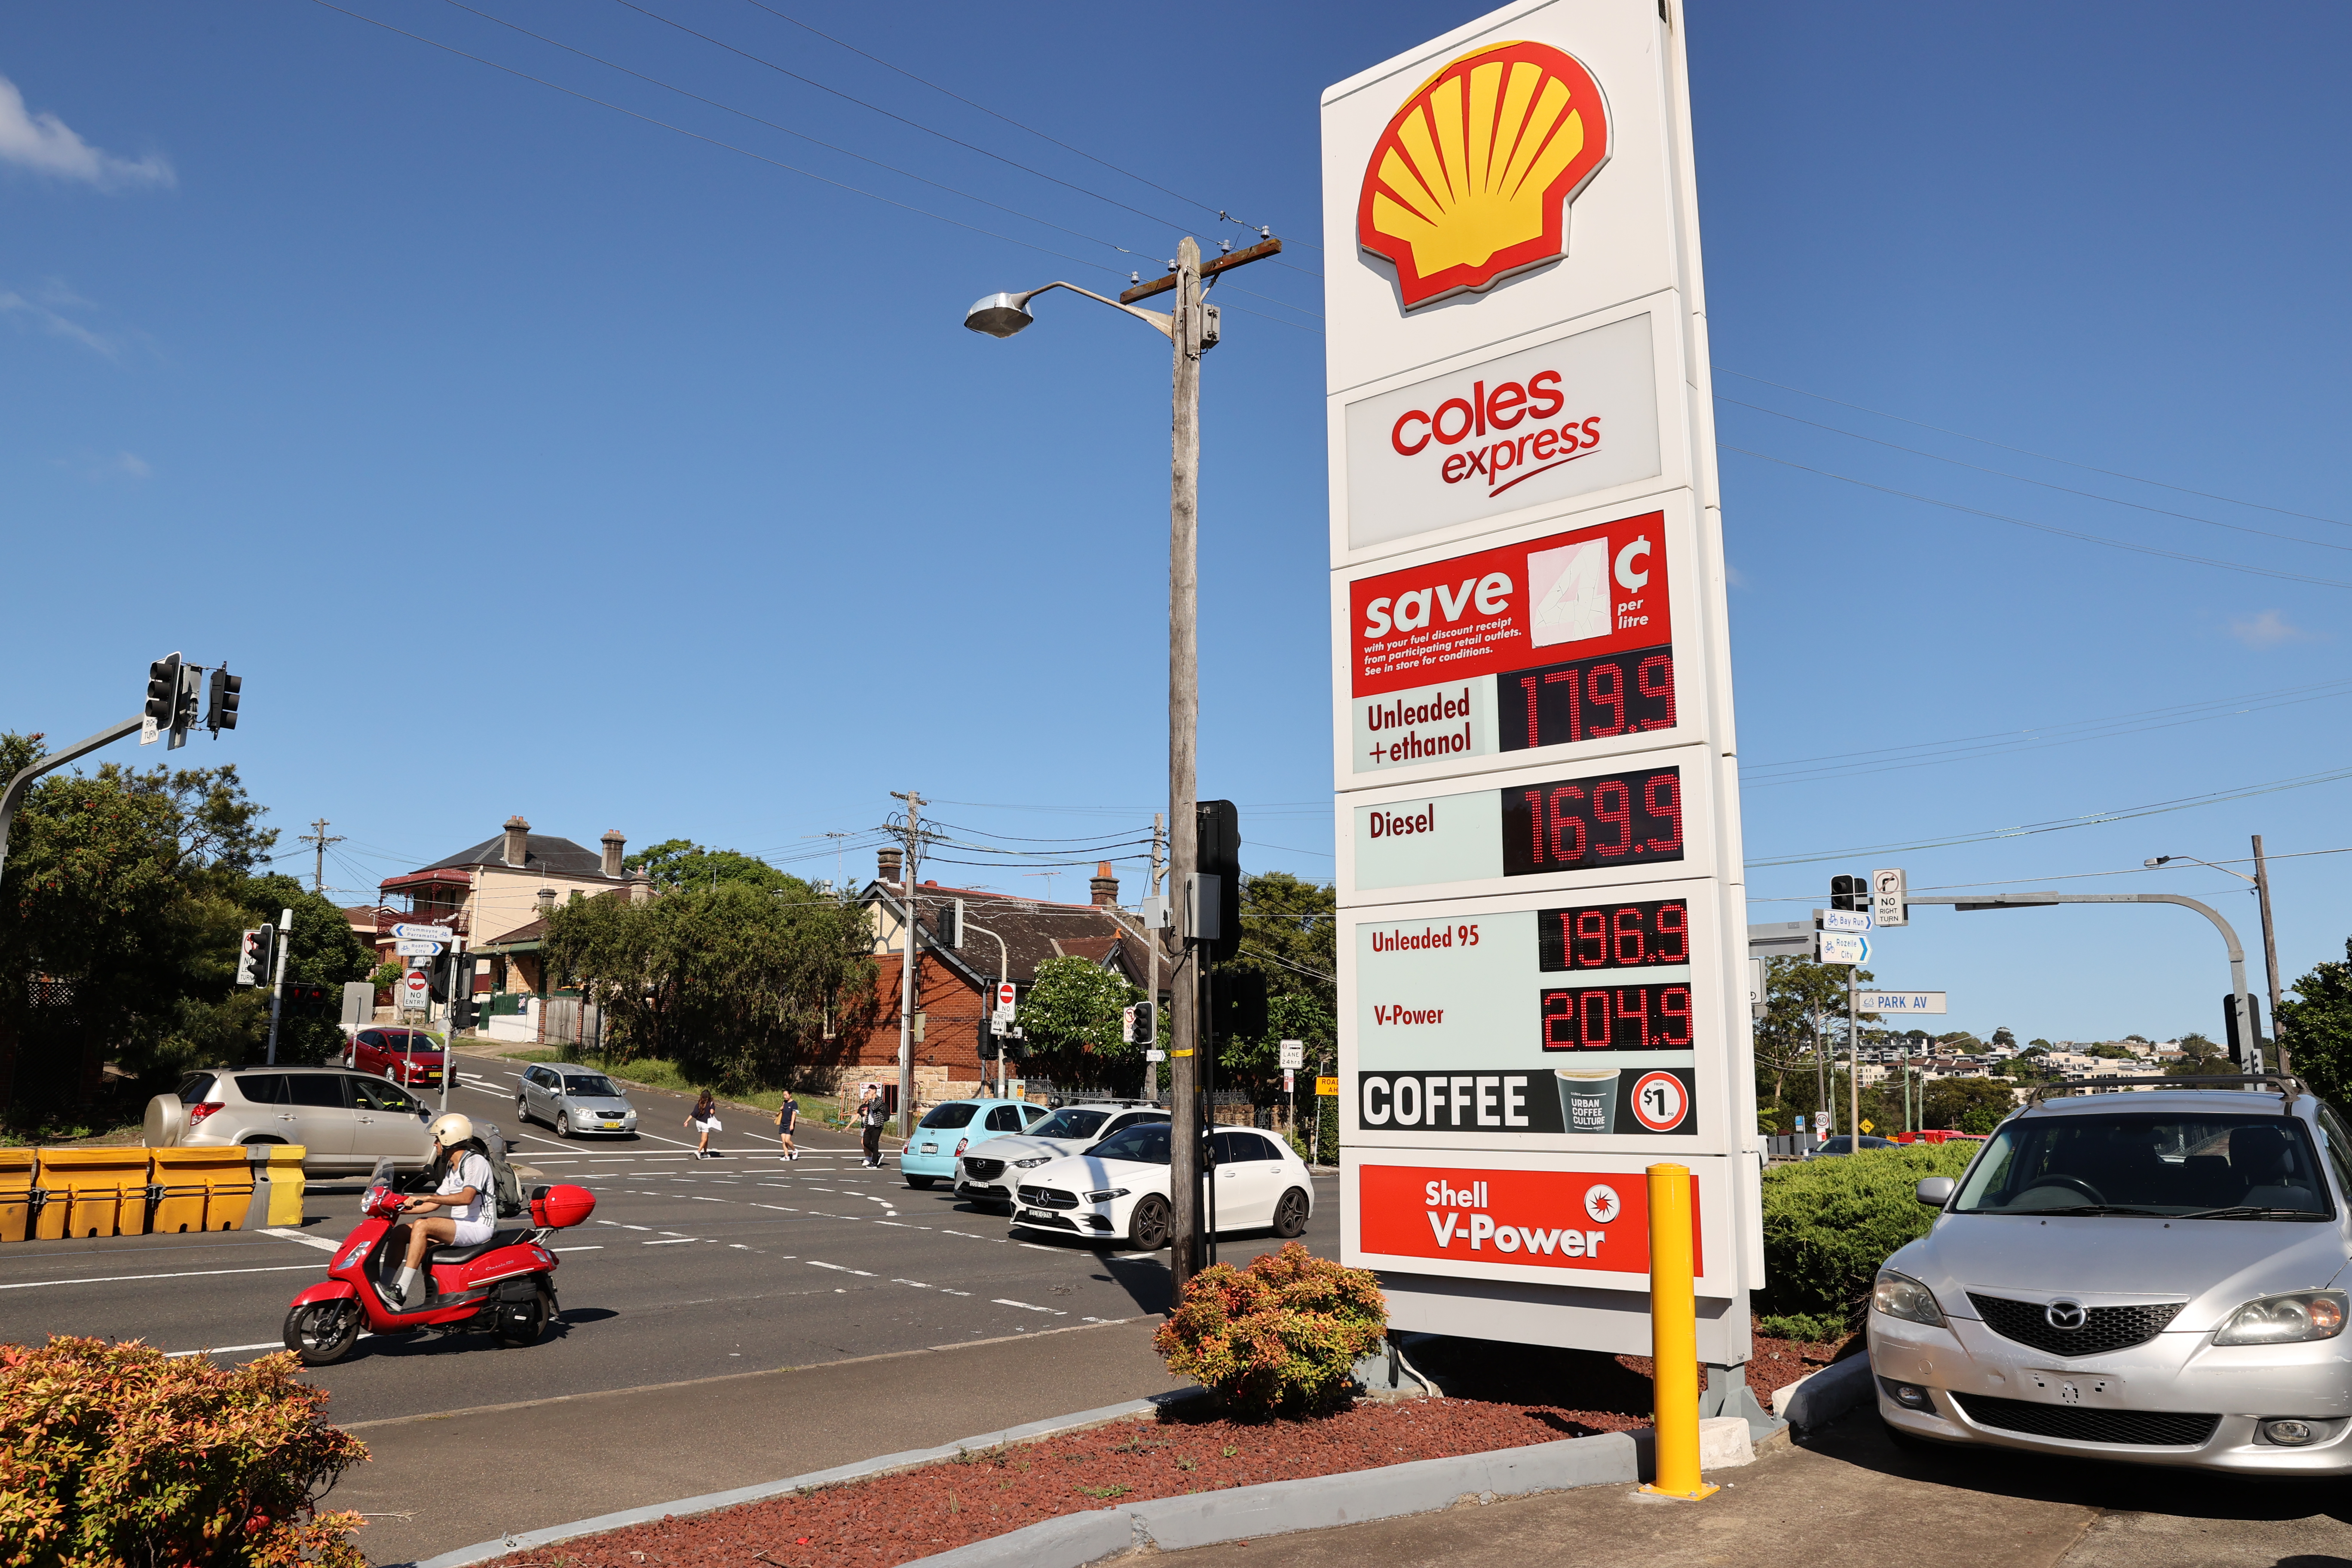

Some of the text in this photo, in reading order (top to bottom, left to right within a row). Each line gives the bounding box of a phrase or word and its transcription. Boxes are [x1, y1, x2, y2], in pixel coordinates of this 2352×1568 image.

[1391, 370, 1565, 456] coles
[1441, 416, 1601, 486] express
[1363, 572, 1513, 639] save
[1617, 599, 1644, 616] per
[1364, 617, 1512, 653] with your fuel discount receipt
[1618, 615, 1649, 629] litre
[1364, 628, 1522, 665] from participating retail outlets.
[1364, 646, 1493, 676] See in store for conditions.
[1368, 654, 1677, 748] Unleaded 179.9
[145, 730, 156, 739] TURN
[146, 718, 157, 728] RIGHT
[1370, 773, 1684, 863] Diesel 169.9
[1881, 897, 1896, 906] NO
[1372, 903, 1689, 967] Unleaded 95 196.9
[1840, 916, 1864, 926] Bay Run
[1836, 938, 1857, 947] Rozelle
[1841, 951, 1853, 961] City
[244, 957, 253, 965] NO
[1878, 996, 1927, 1008] PARK AV
[1374, 986, 1693, 1048] V-Power 204.9
[1363, 1075, 1529, 1127] COFFEE
[1571, 1098, 1600, 1108] URBAN
[1572, 1107, 1603, 1117] COFFEE
[1643, 1088, 1666, 1116] $1
[1573, 1116, 1605, 1125] CULTURE
[1425, 1179, 1488, 1208] Shell
[1425, 1210, 1605, 1259] V-Power
